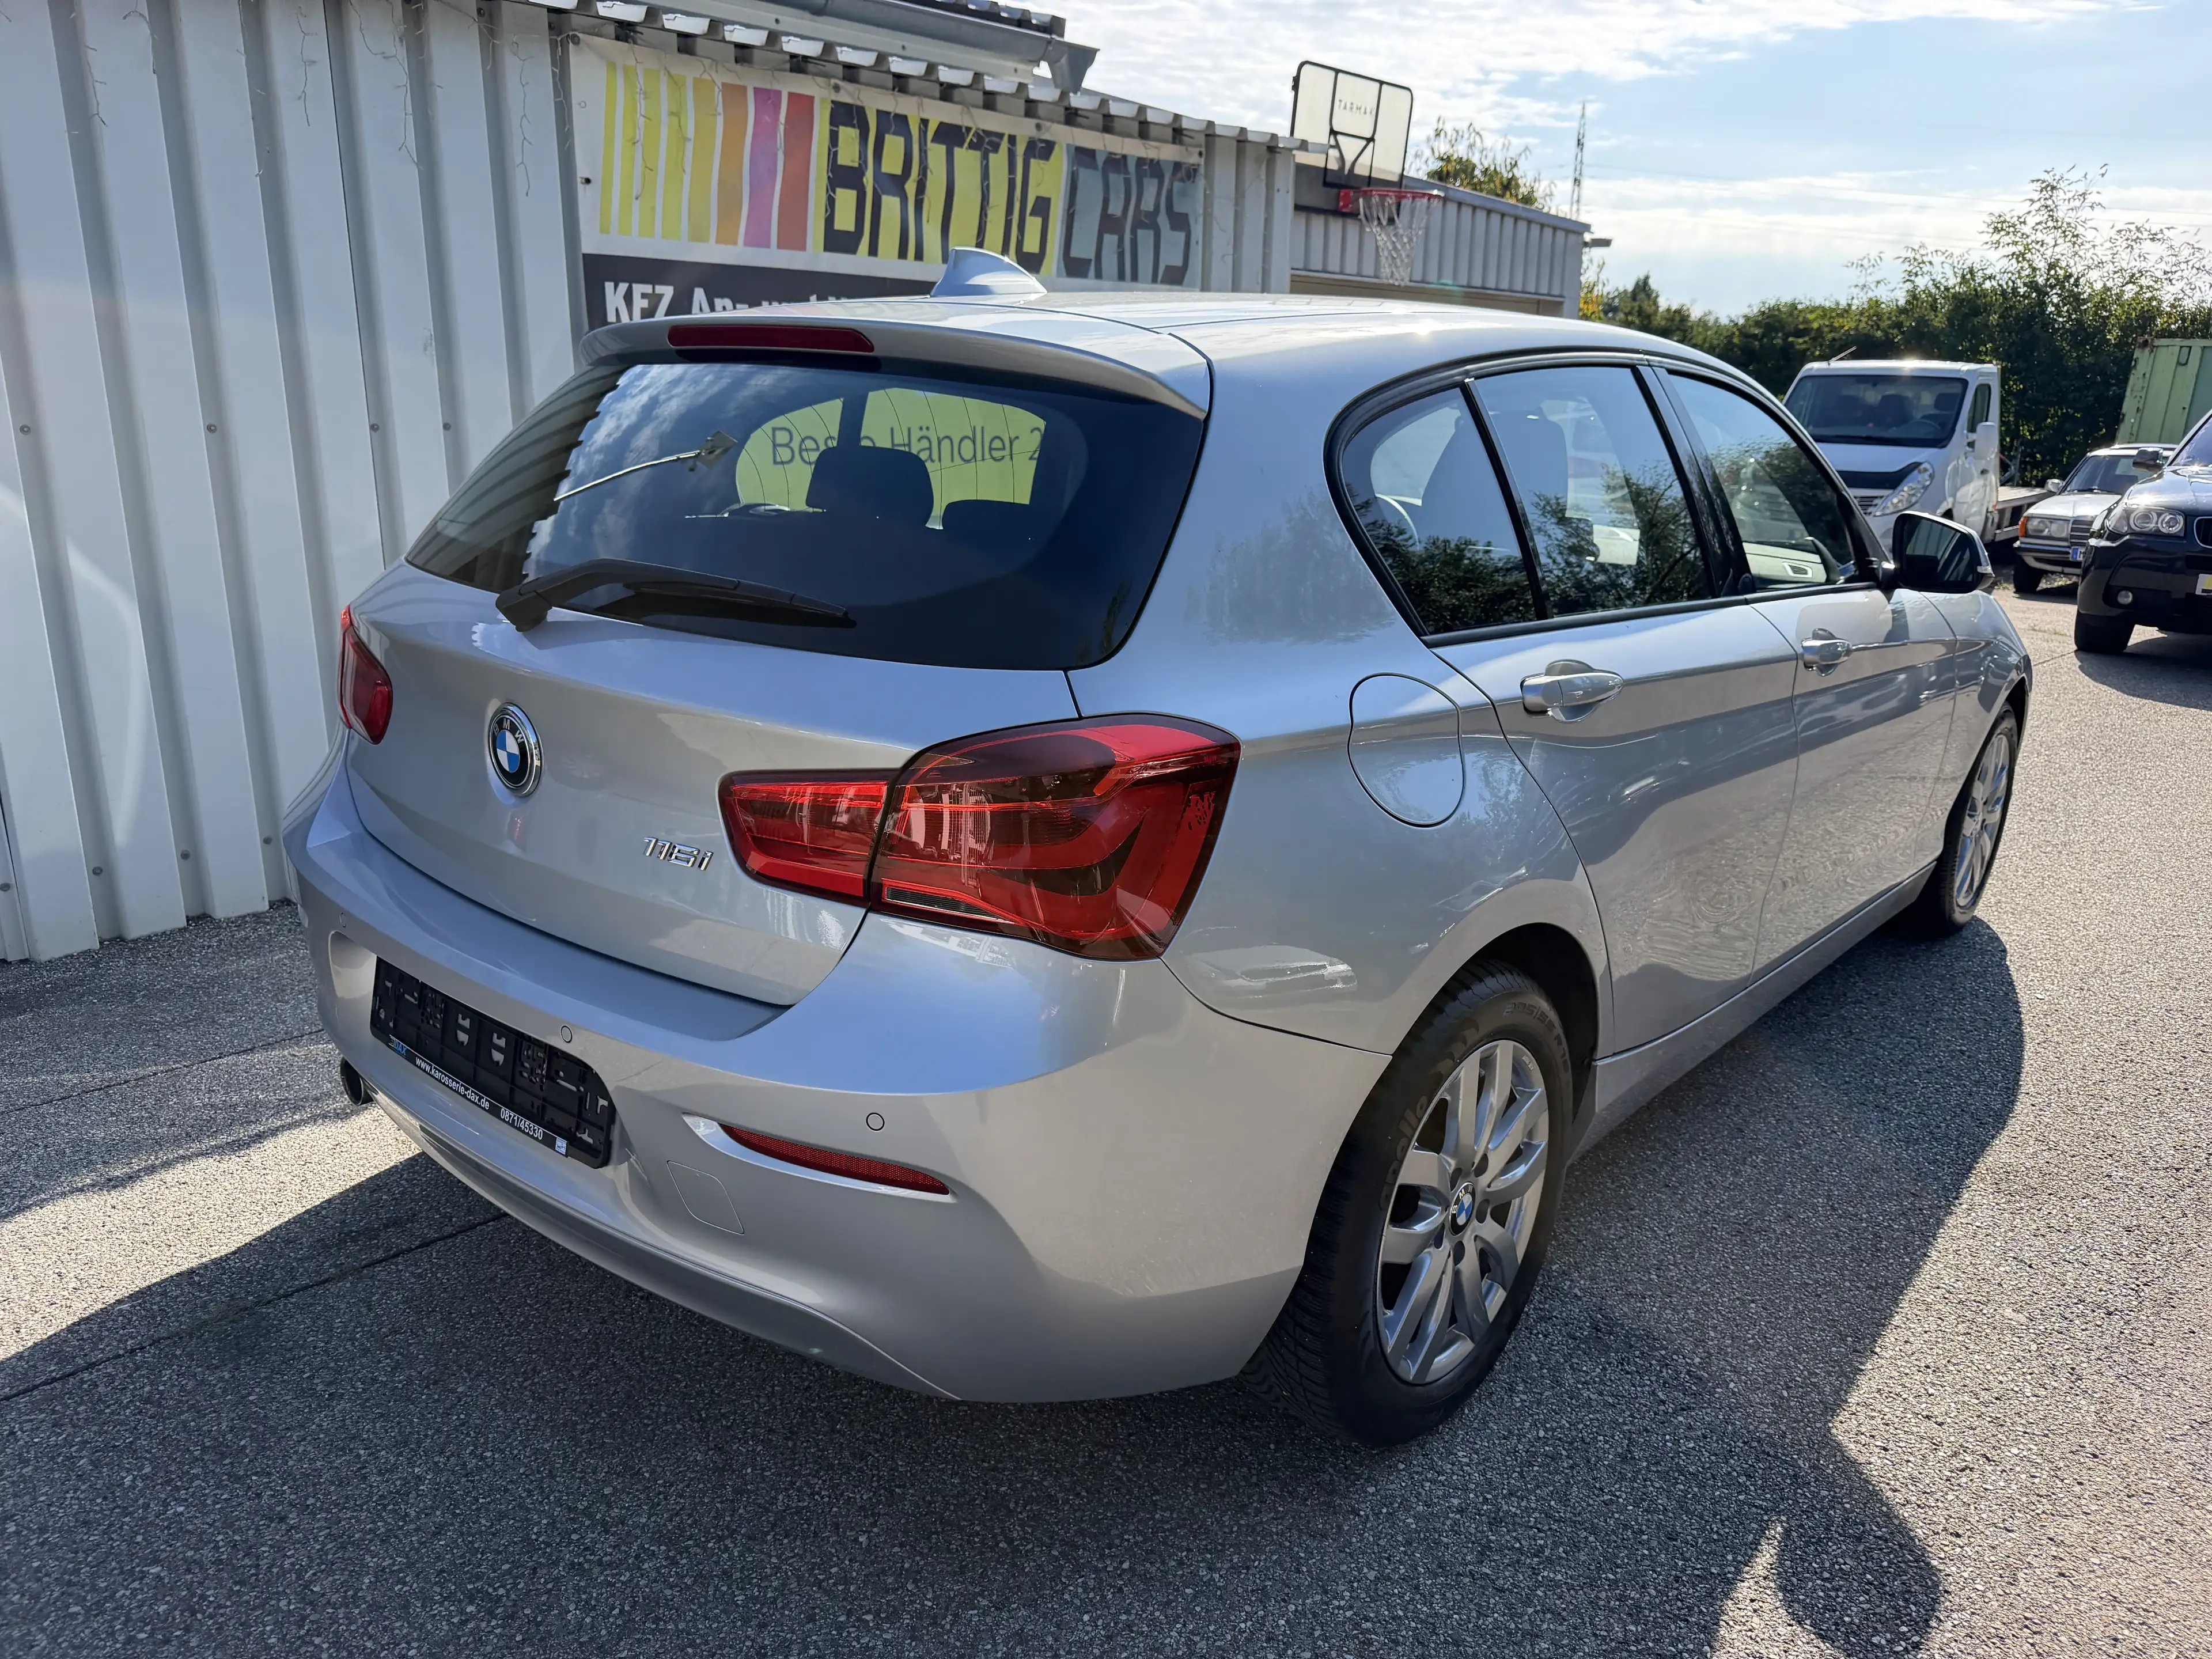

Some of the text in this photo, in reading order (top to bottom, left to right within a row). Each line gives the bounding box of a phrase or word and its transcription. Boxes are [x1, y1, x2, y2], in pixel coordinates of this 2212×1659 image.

[823, 100, 1200, 285] BRITTIG CARS
[604, 281, 674, 323] KFZ
[890, 426, 1020, 463] Händler
[494, 717, 525, 744] BMW
[643, 836, 714, 871] 116i
[415, 1056, 543, 1141] www.karosserie-dax.de 0871/45330
[1378, 1095, 1428, 1211] apollo
[1451, 1184, 1474, 1214] BMW
